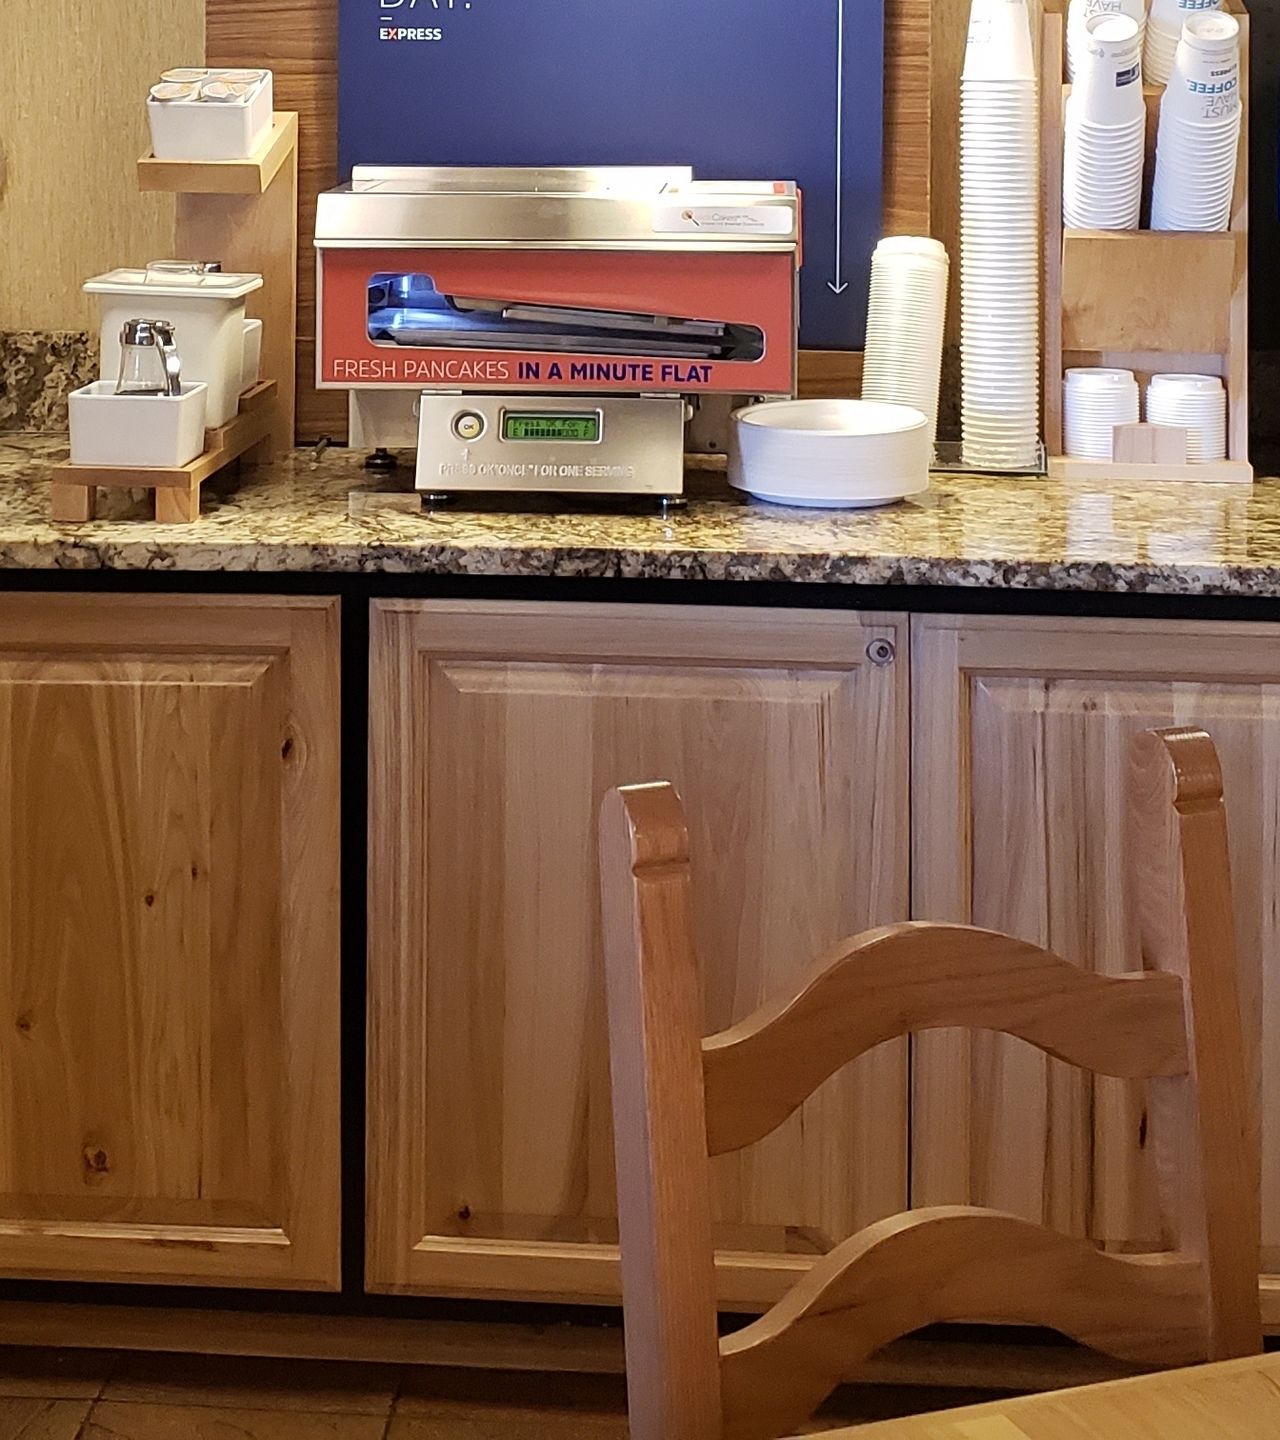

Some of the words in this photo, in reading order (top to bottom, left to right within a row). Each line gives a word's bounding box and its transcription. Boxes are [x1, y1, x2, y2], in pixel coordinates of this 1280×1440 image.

[379, 27, 443, 42] EXPRESS
[332, 359, 396, 378] FRESH
[403, 360, 509, 380] PANCAKES
[518, 362, 541, 380] IN
[547, 362, 563, 381] A
[570, 363, 654, 382] MINUTE
[661, 365, 713, 383] FLAT
[559, 464, 583, 477] ONE
